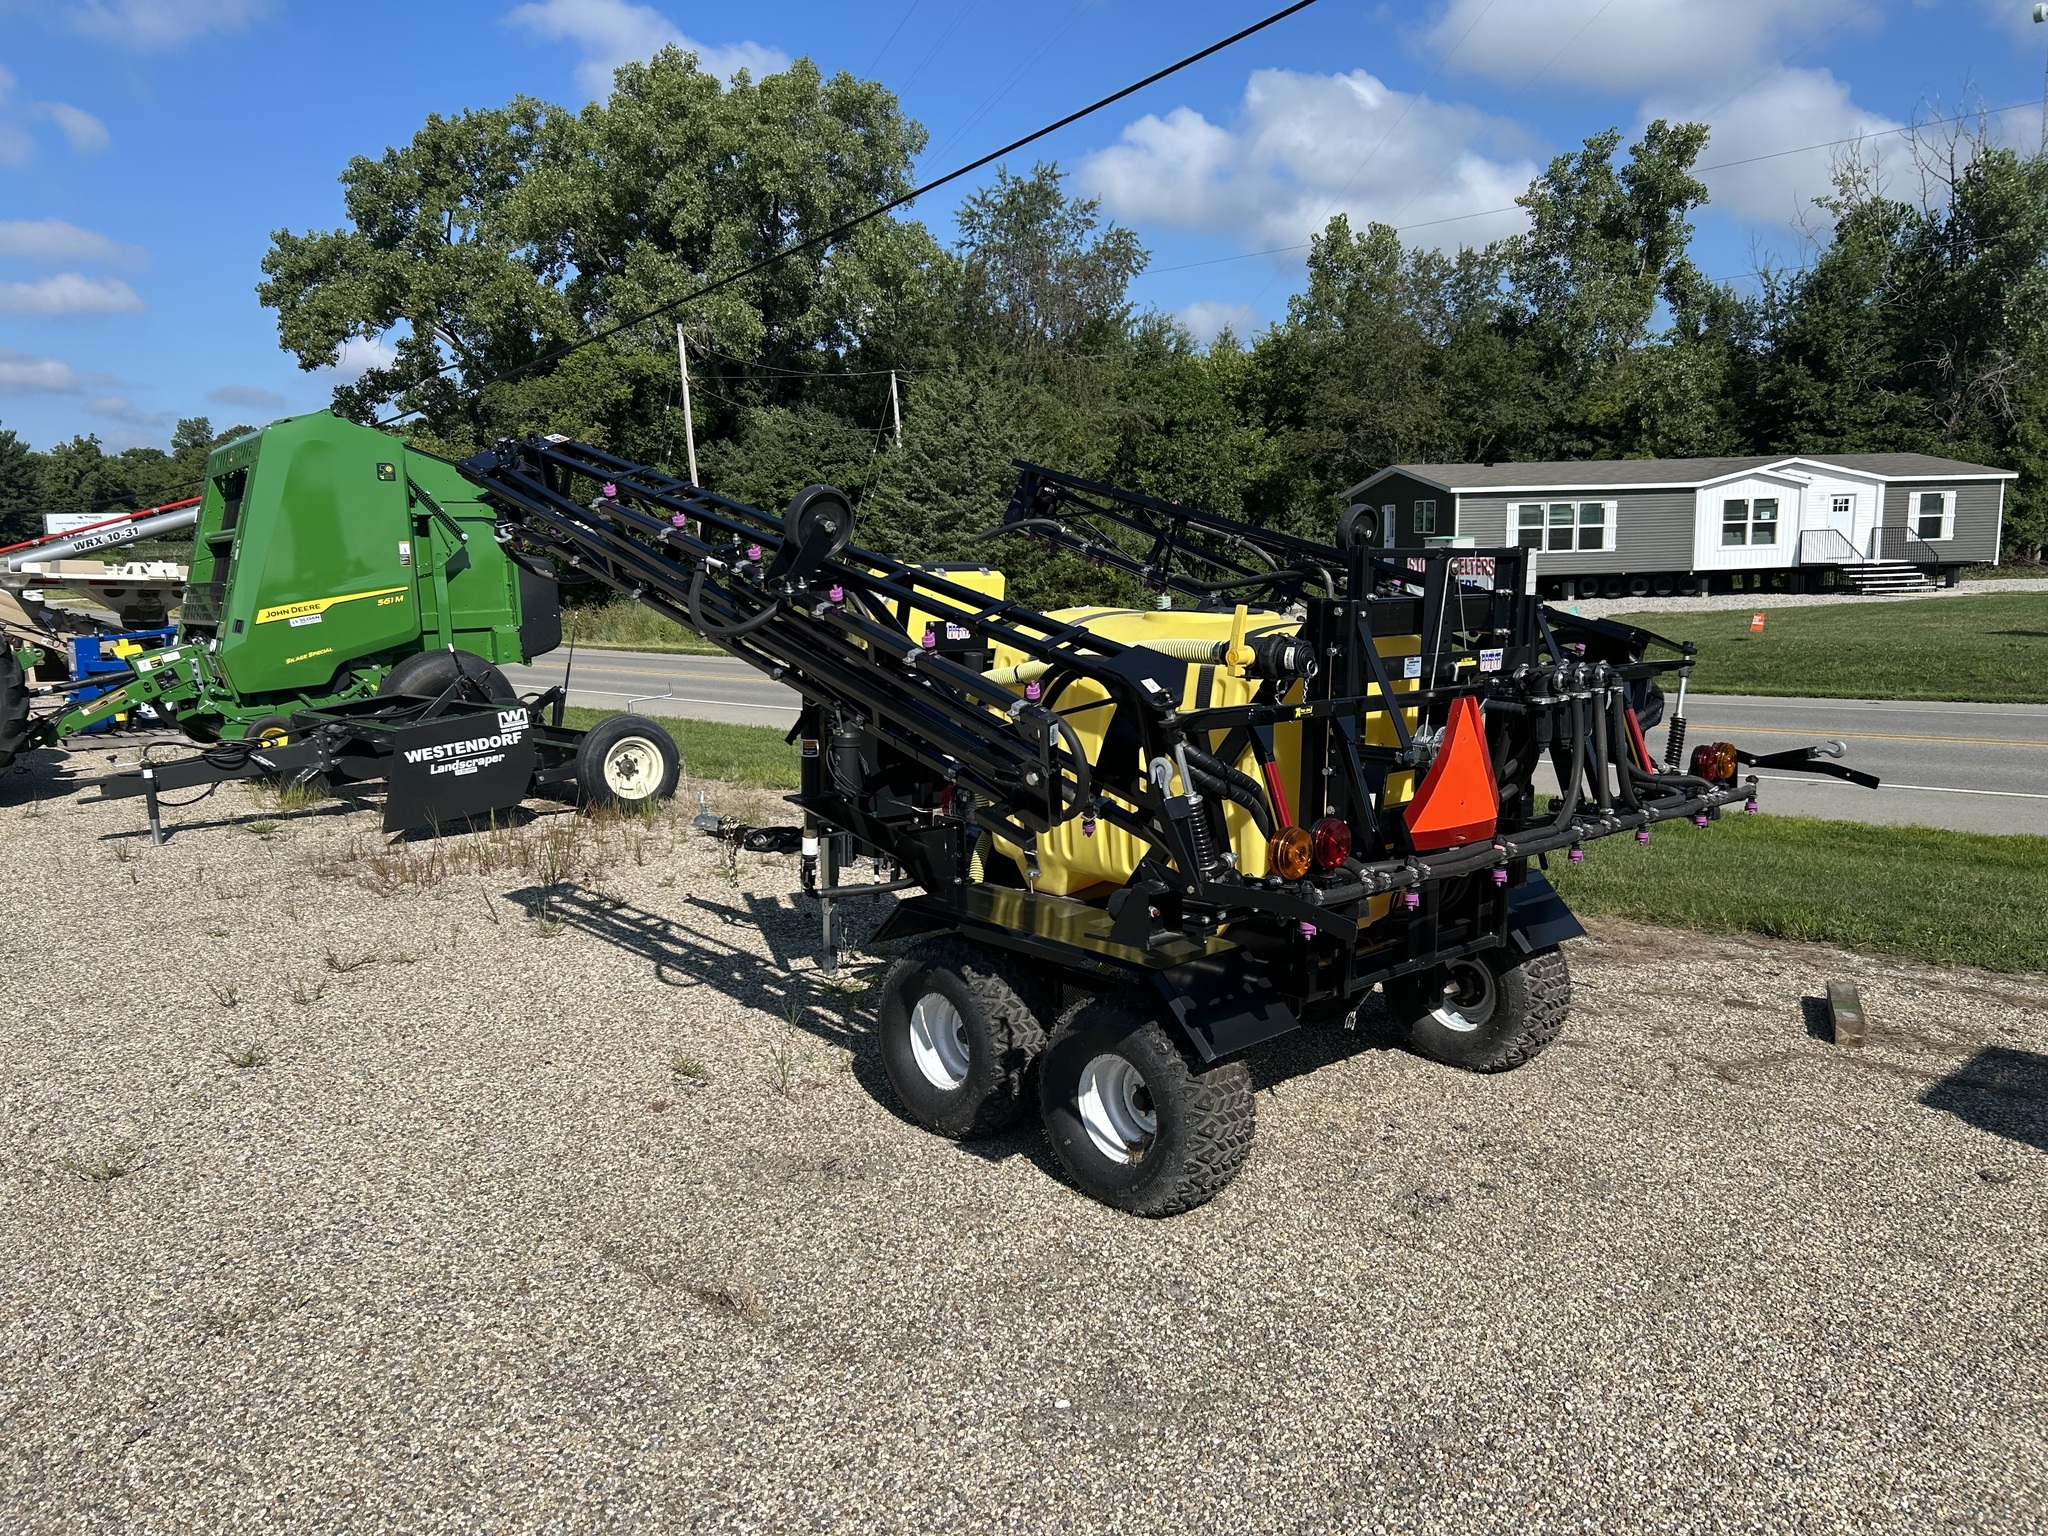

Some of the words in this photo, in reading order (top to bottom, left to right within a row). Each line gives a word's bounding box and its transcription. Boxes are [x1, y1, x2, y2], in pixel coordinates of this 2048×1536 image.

[74, 536, 104, 551] WRX
[107, 526, 140, 542] 10-31
[1458, 558, 1496, 576] ELTERS
[265, 608, 290, 619] JOHN
[290, 603, 321, 614] DEERE
[308, 647, 333, 658] SPECIAL
[403, 731, 522, 763] WESTENDORF
[430, 753, 505, 775] Landscraper
